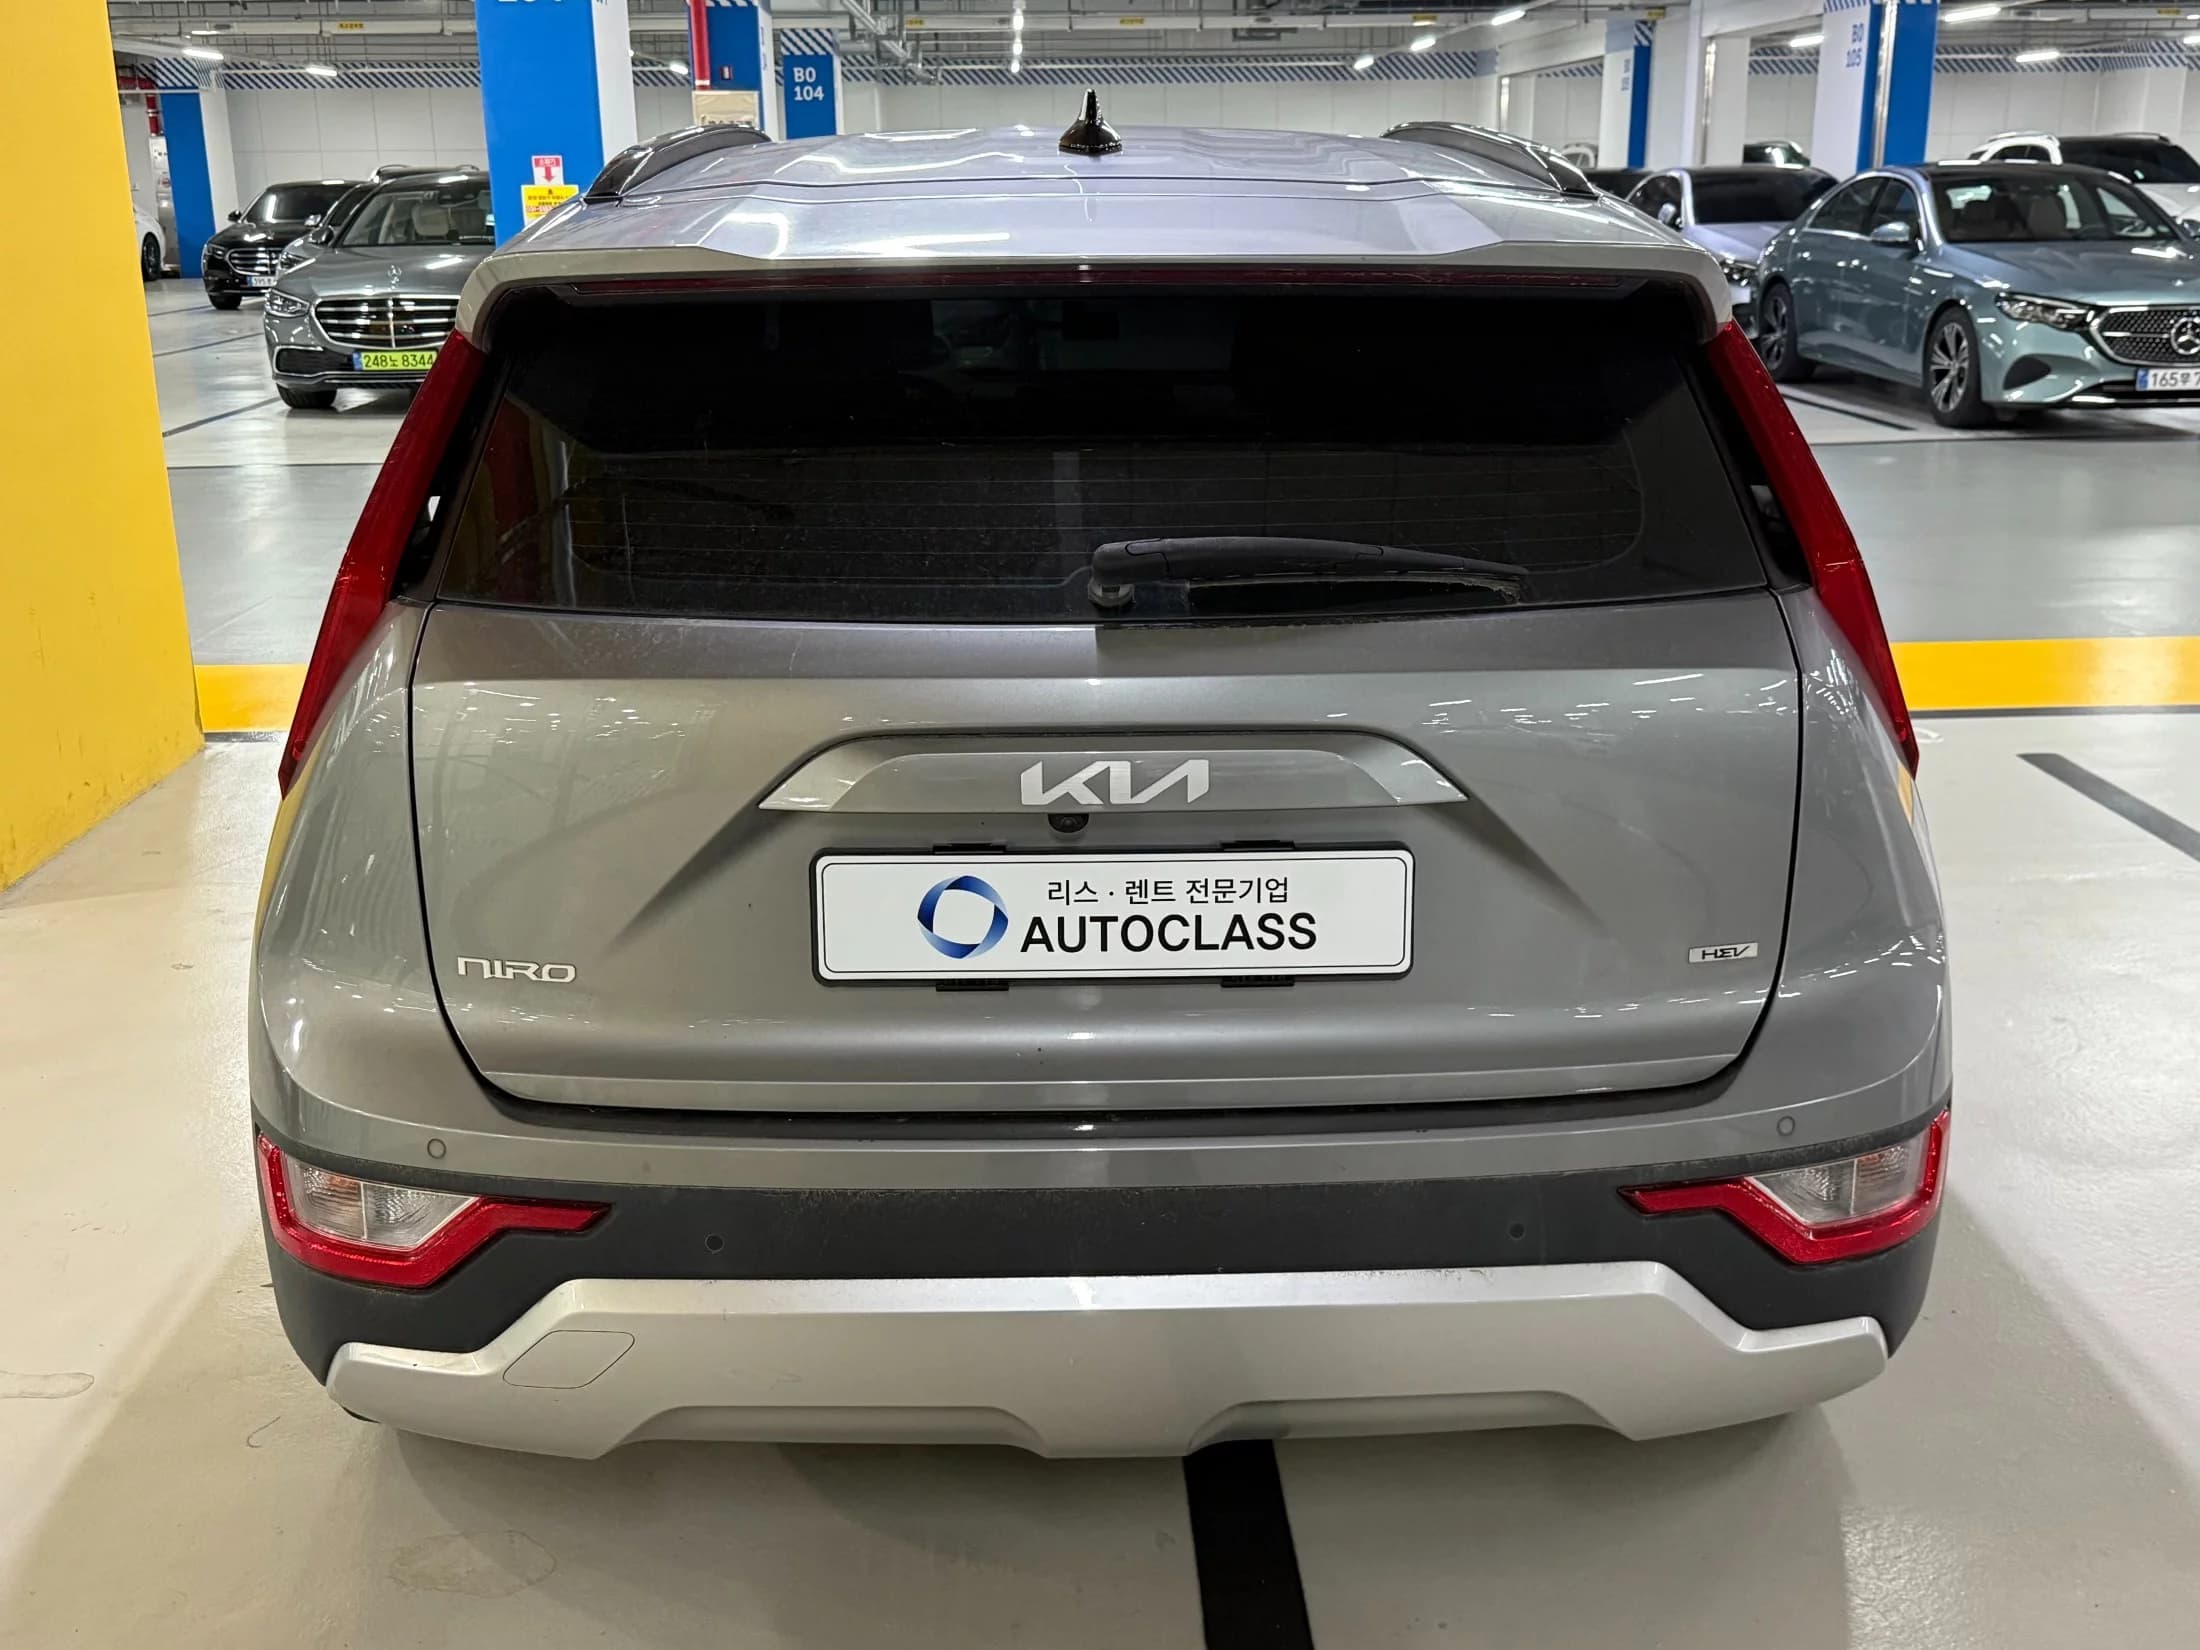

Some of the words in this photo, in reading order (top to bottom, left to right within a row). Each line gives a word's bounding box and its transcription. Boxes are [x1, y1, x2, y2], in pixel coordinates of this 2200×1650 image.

[794, 86, 824, 102] 104
[401, 354, 434, 368] 8344
[1020, 759, 1210, 806] KIA
[1047, 878, 1099, 905] 리스
[1125, 878, 1177, 904] 렌트
[1185, 876, 1289, 904] 전문기업
[1020, 912, 1317, 954] AUTOCLASS
[1701, 945, 1750, 960] HEV
[457, 956, 577, 983] NIRO
